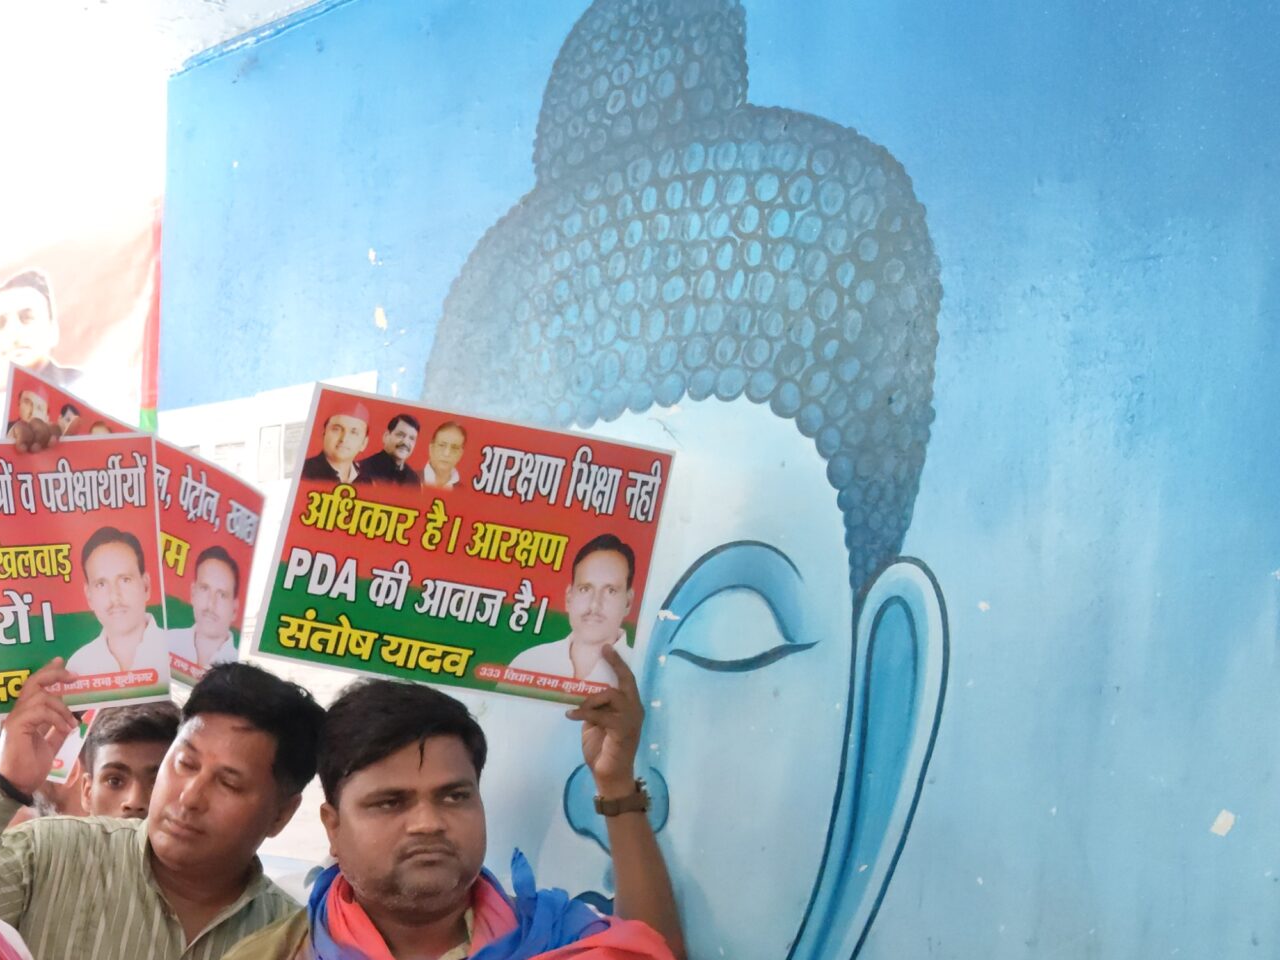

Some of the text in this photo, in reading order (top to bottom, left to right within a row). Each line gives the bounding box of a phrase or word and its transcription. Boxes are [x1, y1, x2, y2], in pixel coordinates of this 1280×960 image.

[17, 473, 37, 514] व
[472, 445, 567, 505] आरक्षण
[564, 444, 623, 516] भिक्षा
[300, 483, 420, 545] अधिकार
[464, 520, 570, 573] आरक्षण
[283, 546, 358, 603] PDA
[368, 559, 412, 611] की
[413, 578, 507, 628] आवाज
[277, 606, 475, 678] संतोष यादव
[478, 666, 501, 680] 333
[503, 668, 535, 685] विधान
